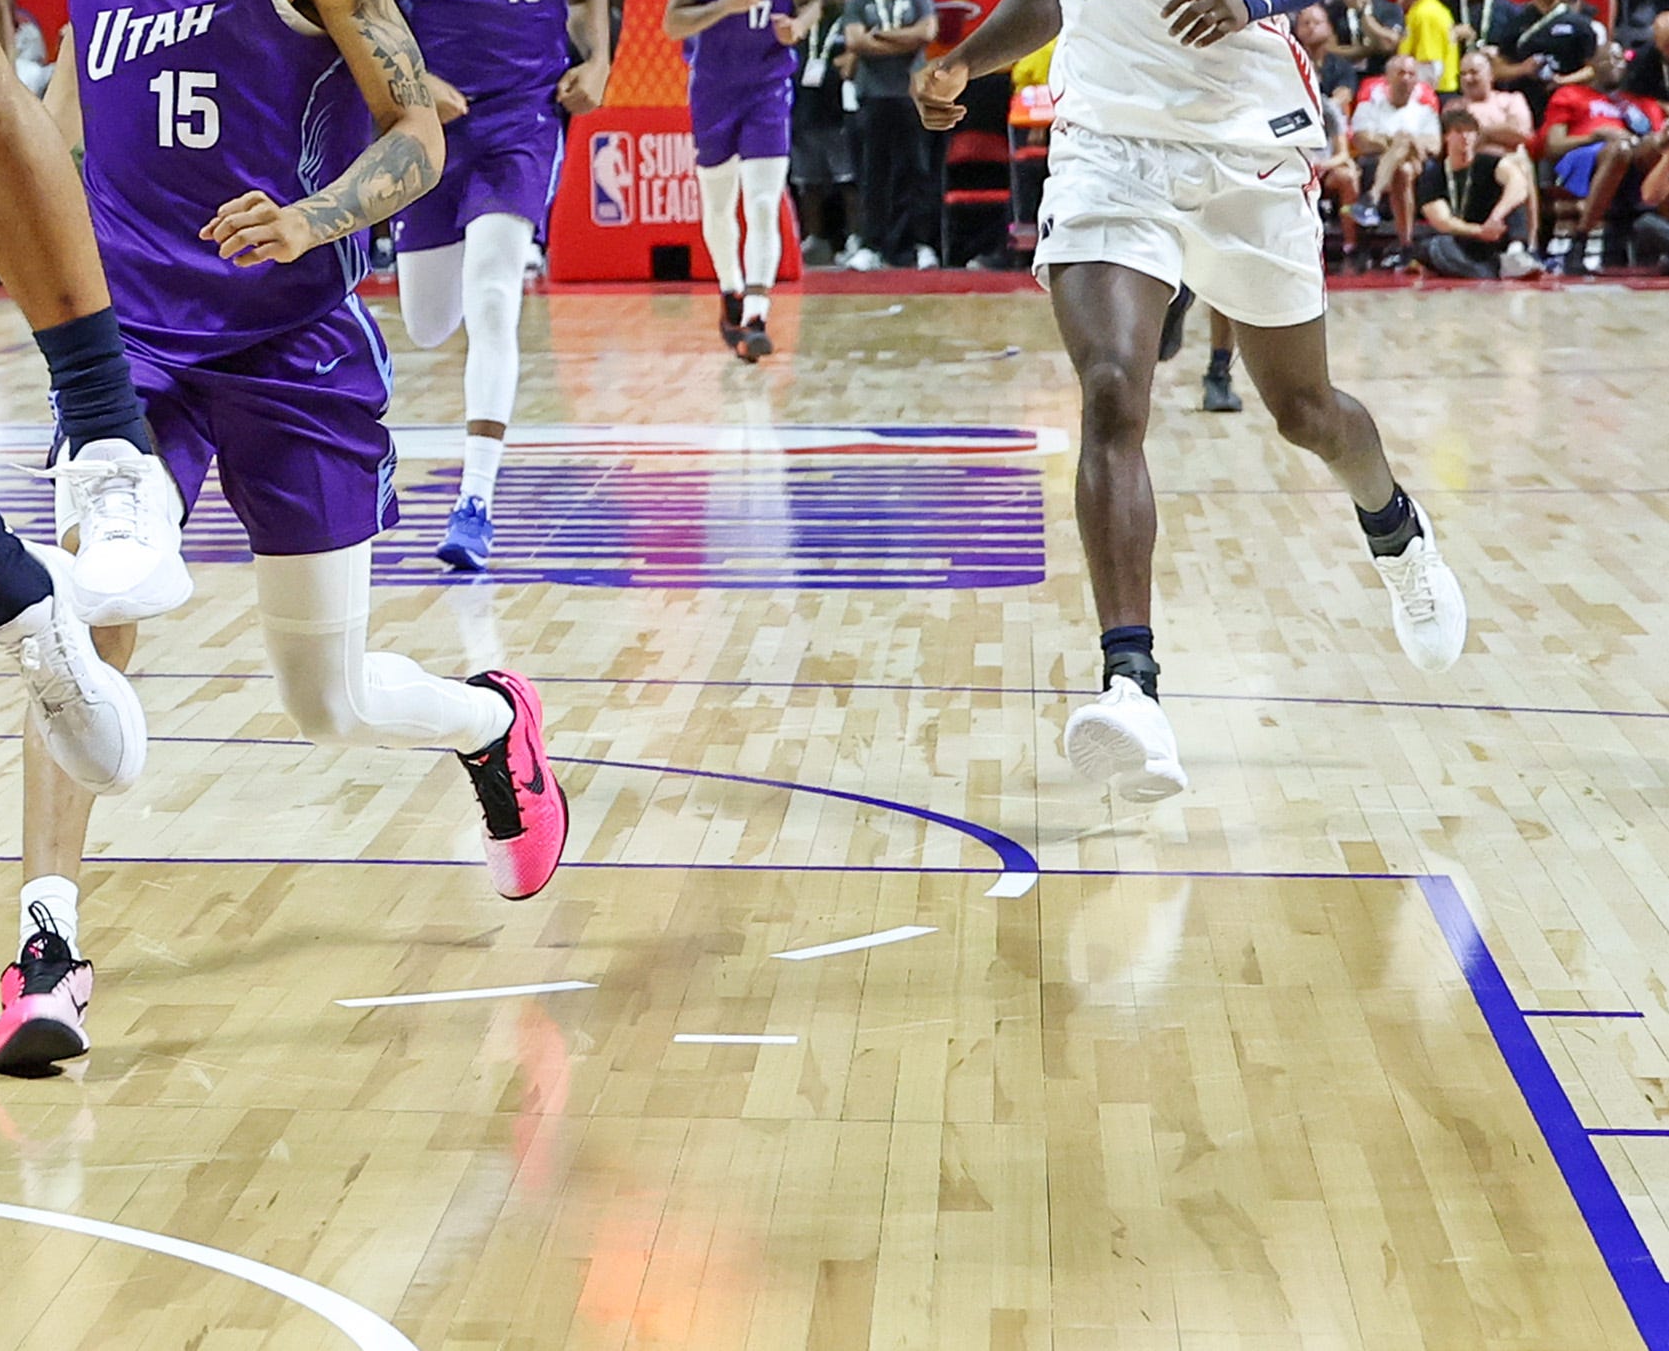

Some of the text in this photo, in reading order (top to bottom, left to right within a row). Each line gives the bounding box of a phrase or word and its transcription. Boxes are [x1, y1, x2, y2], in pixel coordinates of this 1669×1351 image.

[87, 3, 216, 81] UTAH
[749, 0, 771, 29] 17
[149, 70, 221, 149] 15
[638, 178, 702, 224] LEAG
